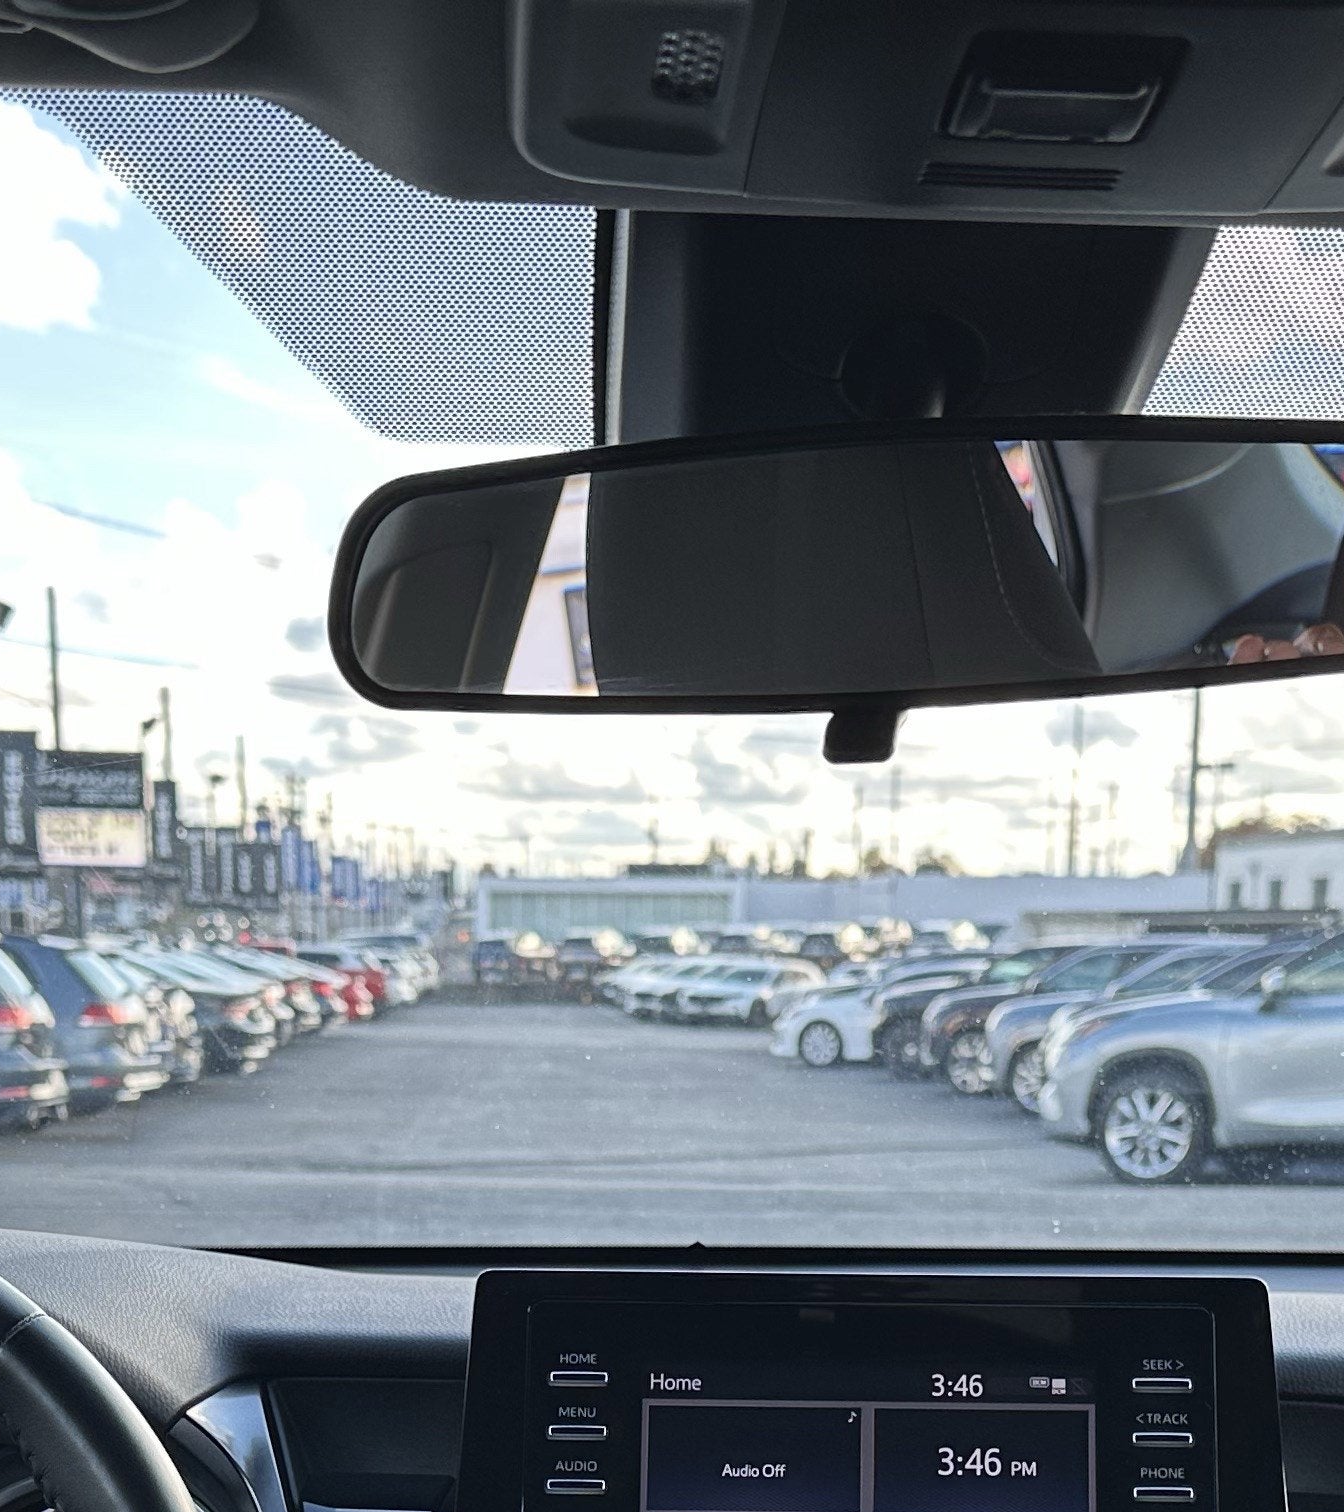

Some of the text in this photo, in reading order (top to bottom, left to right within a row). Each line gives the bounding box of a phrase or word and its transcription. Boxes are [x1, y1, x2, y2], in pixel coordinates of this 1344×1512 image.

[559, 1353, 597, 1365] HOME
[1142, 1359, 1173, 1371] SEEK
[650, 1372, 702, 1391] Home
[931, 1373, 984, 1398] 3:46
[558, 1406, 597, 1418] MENU
[1146, 1413, 1188, 1425] TRACK
[555, 1460, 598, 1472] AUDIO
[937, 1447, 1037, 1477] 3:46 PM
[721, 1463, 786, 1478] Audio Off
[1140, 1466, 1185, 1479] PHONE
